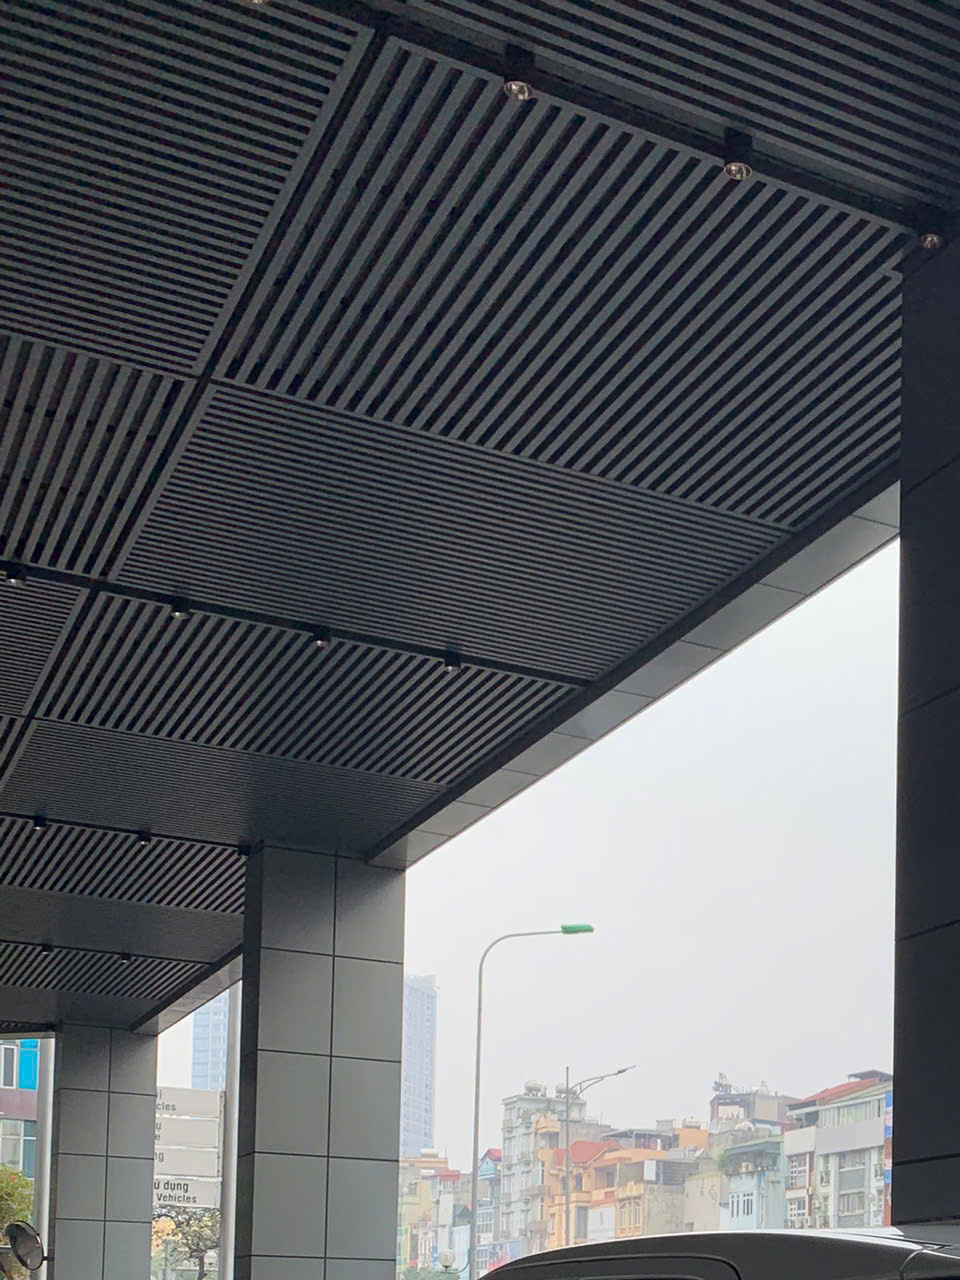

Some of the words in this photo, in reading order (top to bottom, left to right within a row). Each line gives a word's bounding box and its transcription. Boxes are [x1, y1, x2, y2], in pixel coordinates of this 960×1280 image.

[156, 1102, 177, 1112] cles
[163, 1180, 189, 1193] dụng
[156, 1193, 197, 1204] Vehicles
